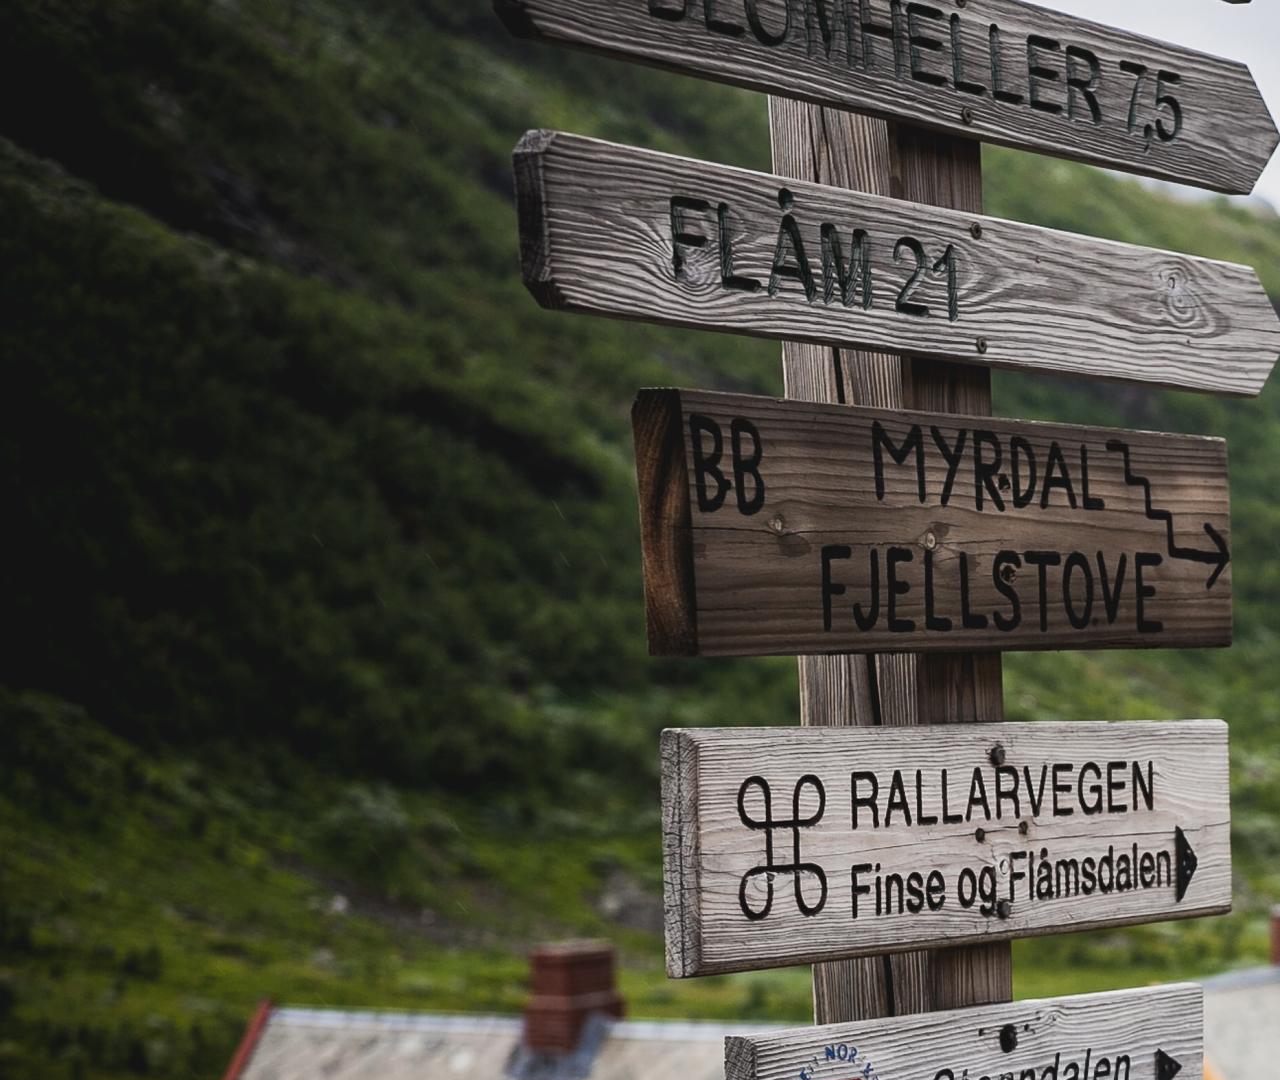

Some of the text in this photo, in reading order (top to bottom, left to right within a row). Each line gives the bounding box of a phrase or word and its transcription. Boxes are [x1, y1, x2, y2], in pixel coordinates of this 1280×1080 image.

[647, 0, 1184, 152] OMHELLER 7,5
[668, 187, 960, 323] FLÅM 21
[688, 413, 1106, 516] BB MYRDAL
[820, 544, 1164, 633] FJELLSTOVE
[850, 759, 1155, 829] RALLARVEGEN
[850, 842, 1173, 919] Finse og Flåmsdalen
